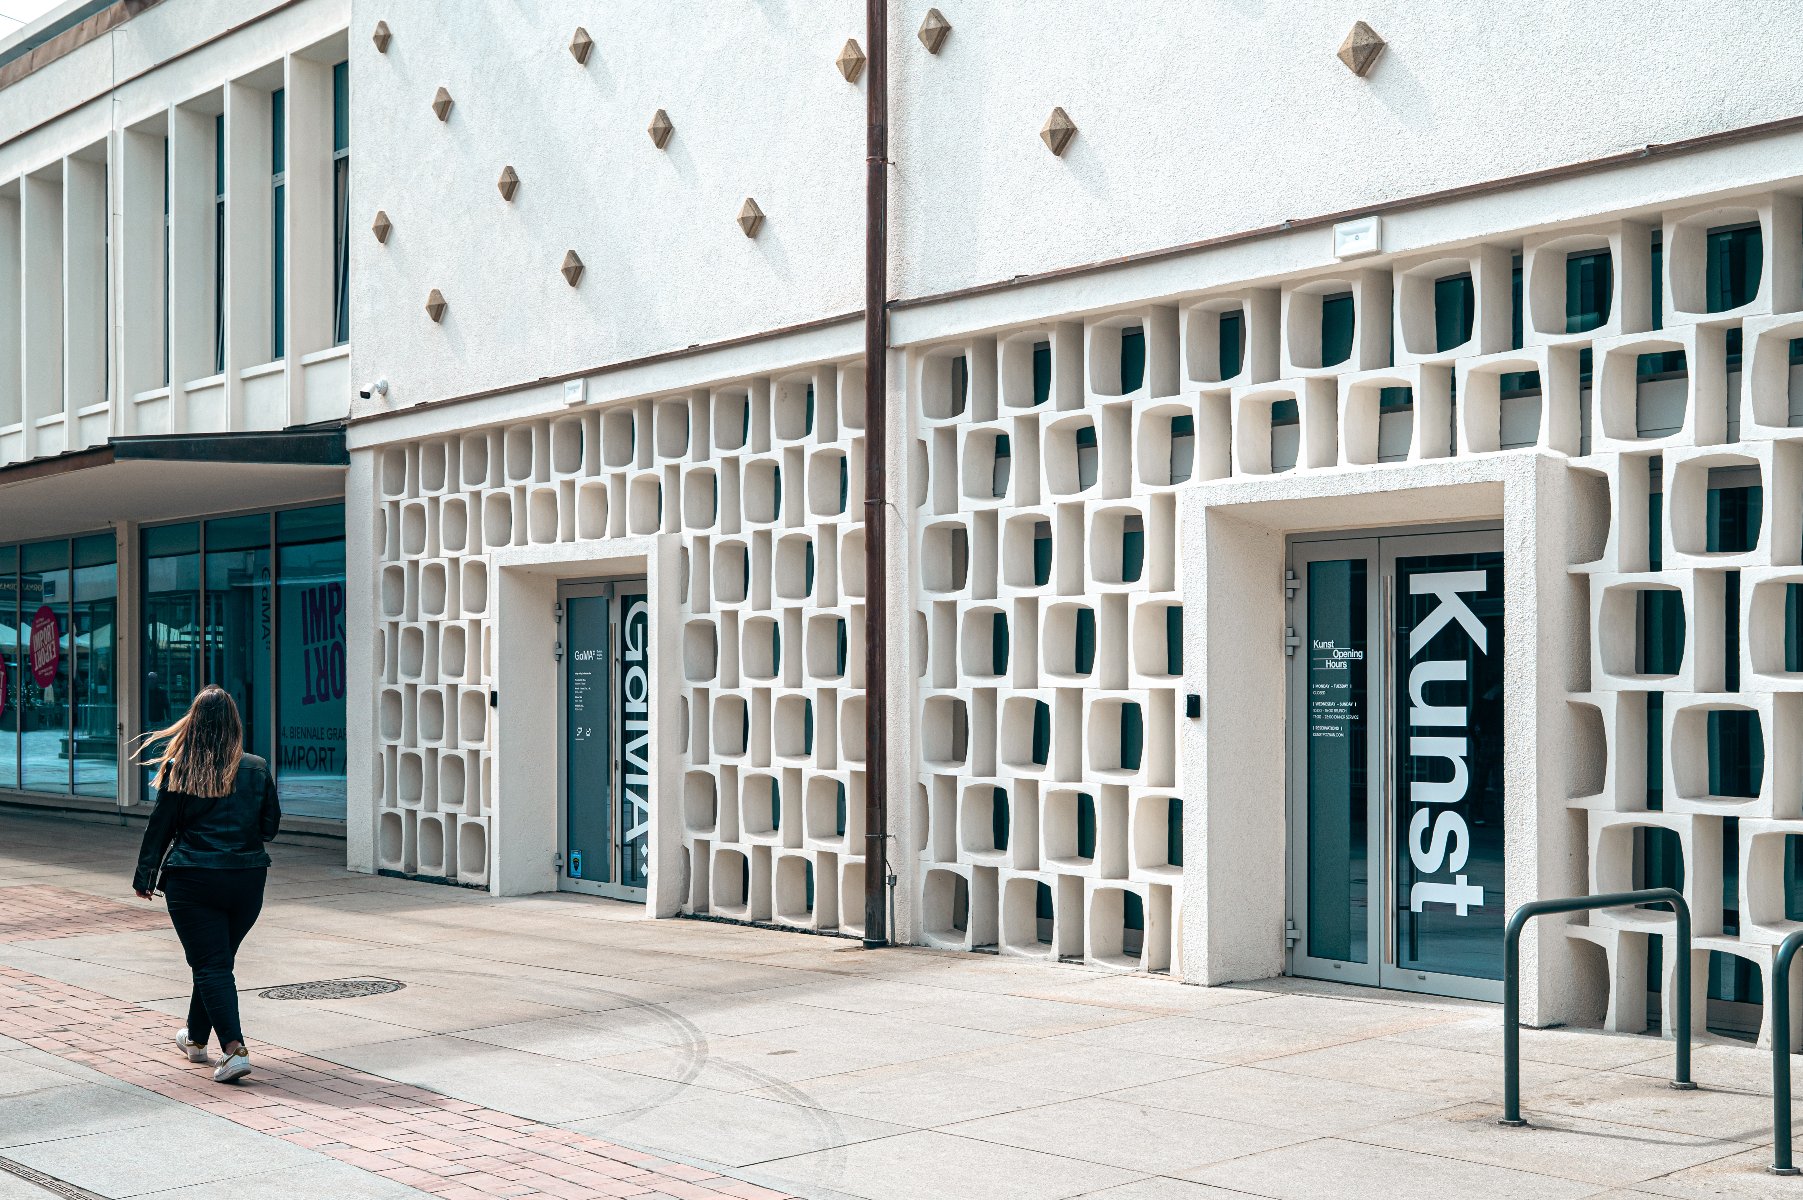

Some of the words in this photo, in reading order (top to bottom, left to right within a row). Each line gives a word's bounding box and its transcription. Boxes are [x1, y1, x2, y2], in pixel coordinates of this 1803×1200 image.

[301, 582, 346, 646] IMP
[32, 622, 55, 652] IMPORT
[1313, 640, 1334, 649] Kunst
[1325, 660, 1348, 668] Hours
[1332, 649, 1363, 660] Opening
[289, 726, 325, 740] BIENNALE
[1409, 570, 1487, 916] Kunst
[279, 745, 336, 772] IMPORT
